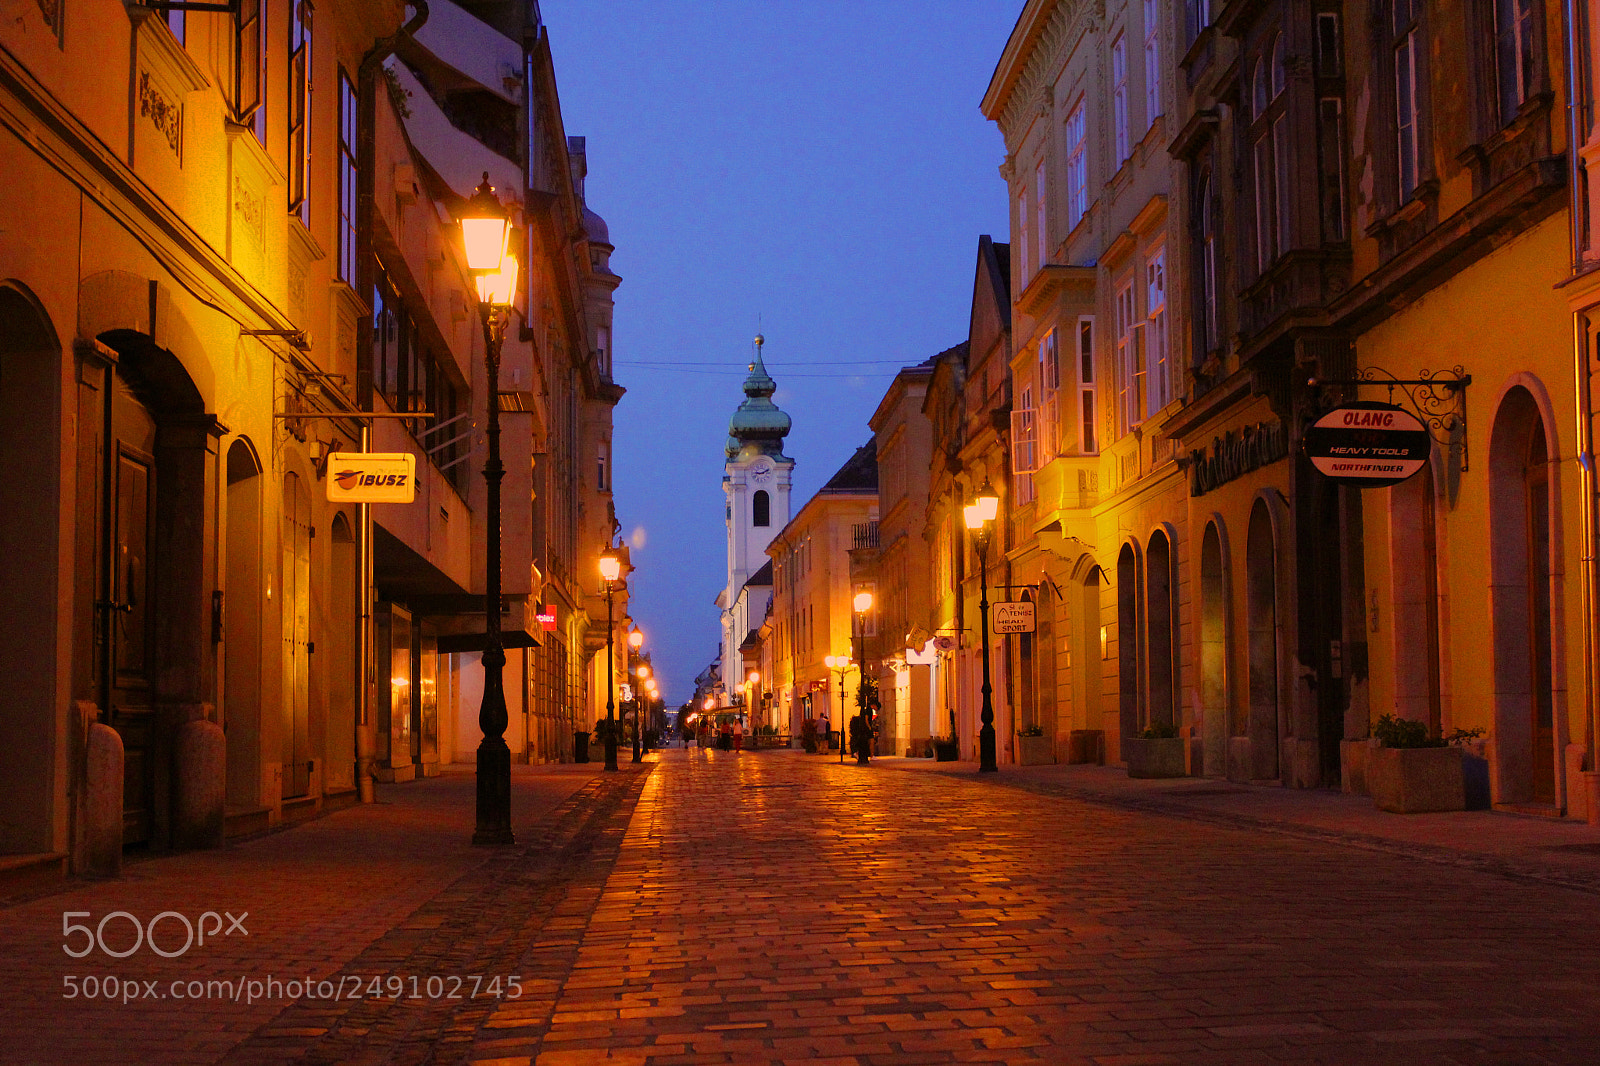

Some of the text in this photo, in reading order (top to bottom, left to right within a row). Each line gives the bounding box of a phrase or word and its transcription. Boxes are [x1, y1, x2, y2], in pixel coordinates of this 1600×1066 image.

[1343, 412, 1394, 427] OLANG
[1330, 447, 1410, 456] HEAVY TOOLS
[1332, 463, 1404, 473] NORTHFINDER
[359, 475, 408, 486] IBUSZ
